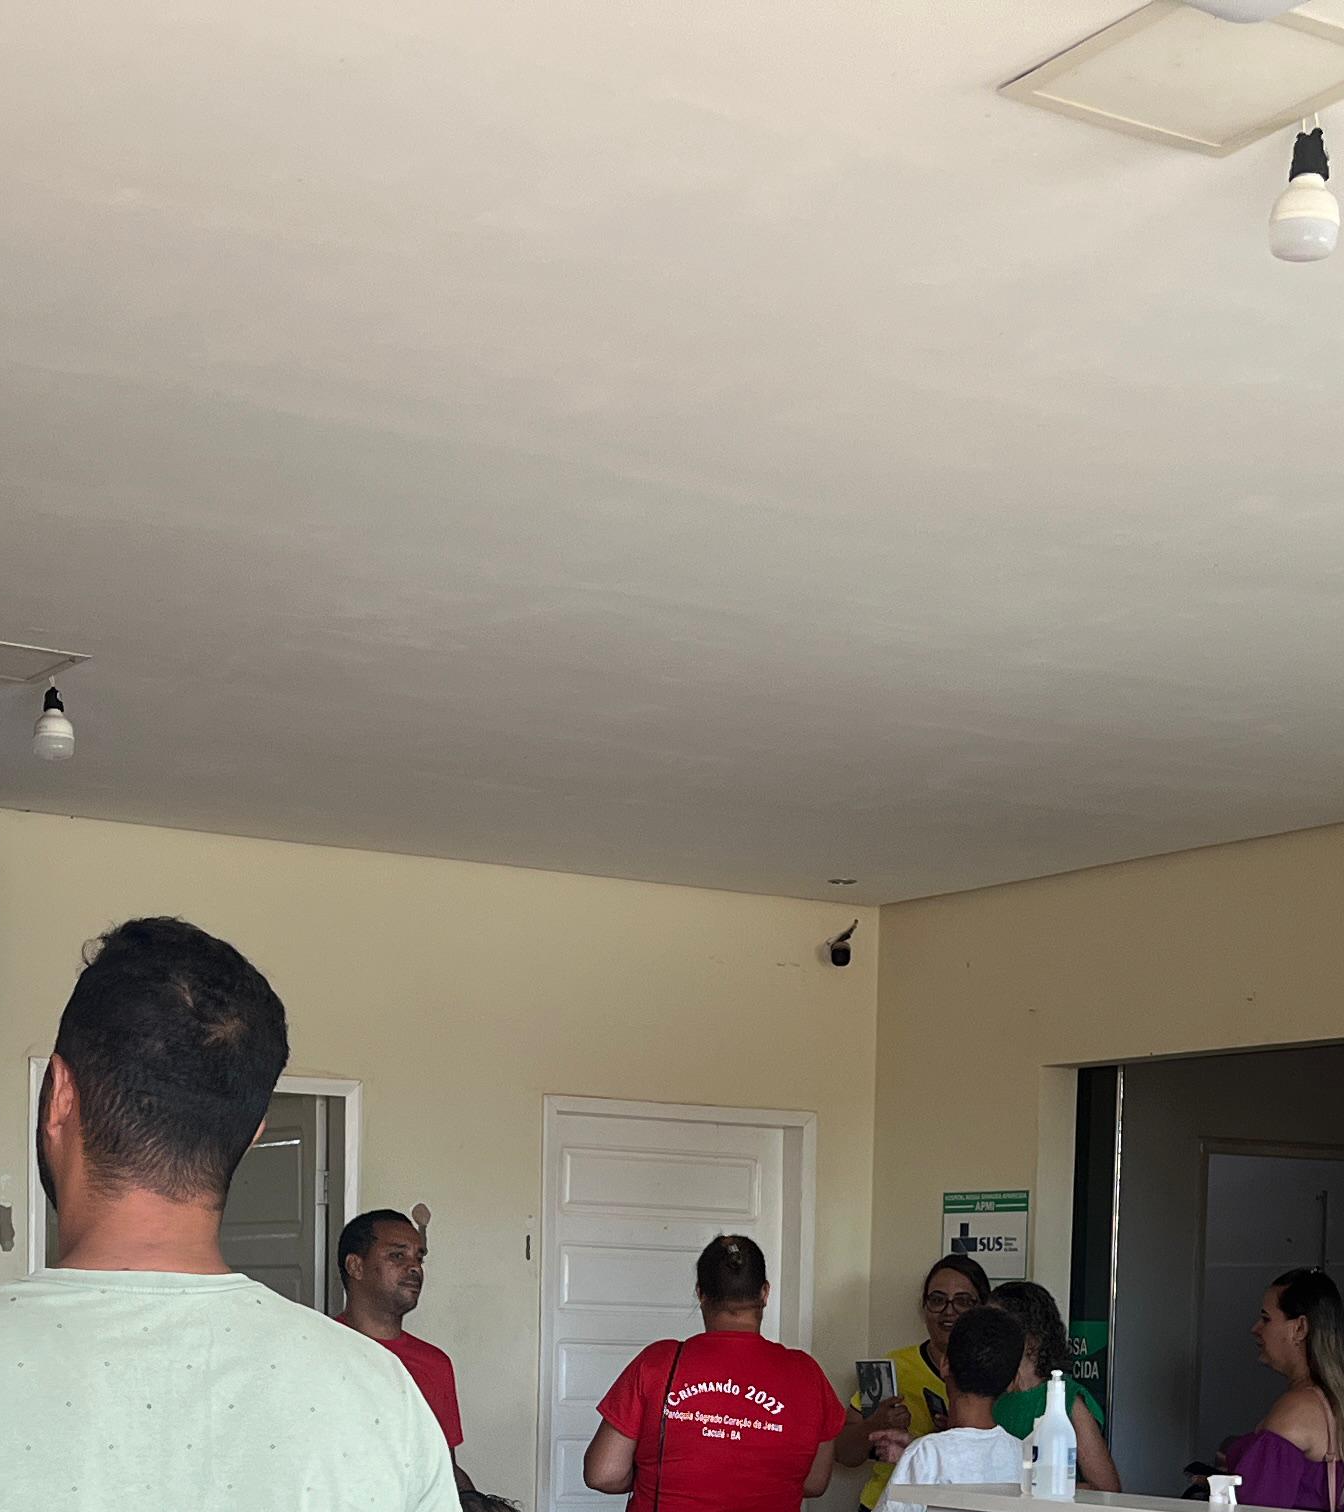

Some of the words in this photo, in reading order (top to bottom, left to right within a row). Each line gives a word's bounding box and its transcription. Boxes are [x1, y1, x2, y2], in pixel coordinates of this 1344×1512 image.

[979, 1236, 1003, 1252] SUS
[744, 1385, 785, 1415] 2023
[695, 1410, 722, 1424] Sagrado
[723, 1415, 751, 1428] Coração
[752, 1419, 762, 1429] de
[731, 1431, 741, 1440] BA
